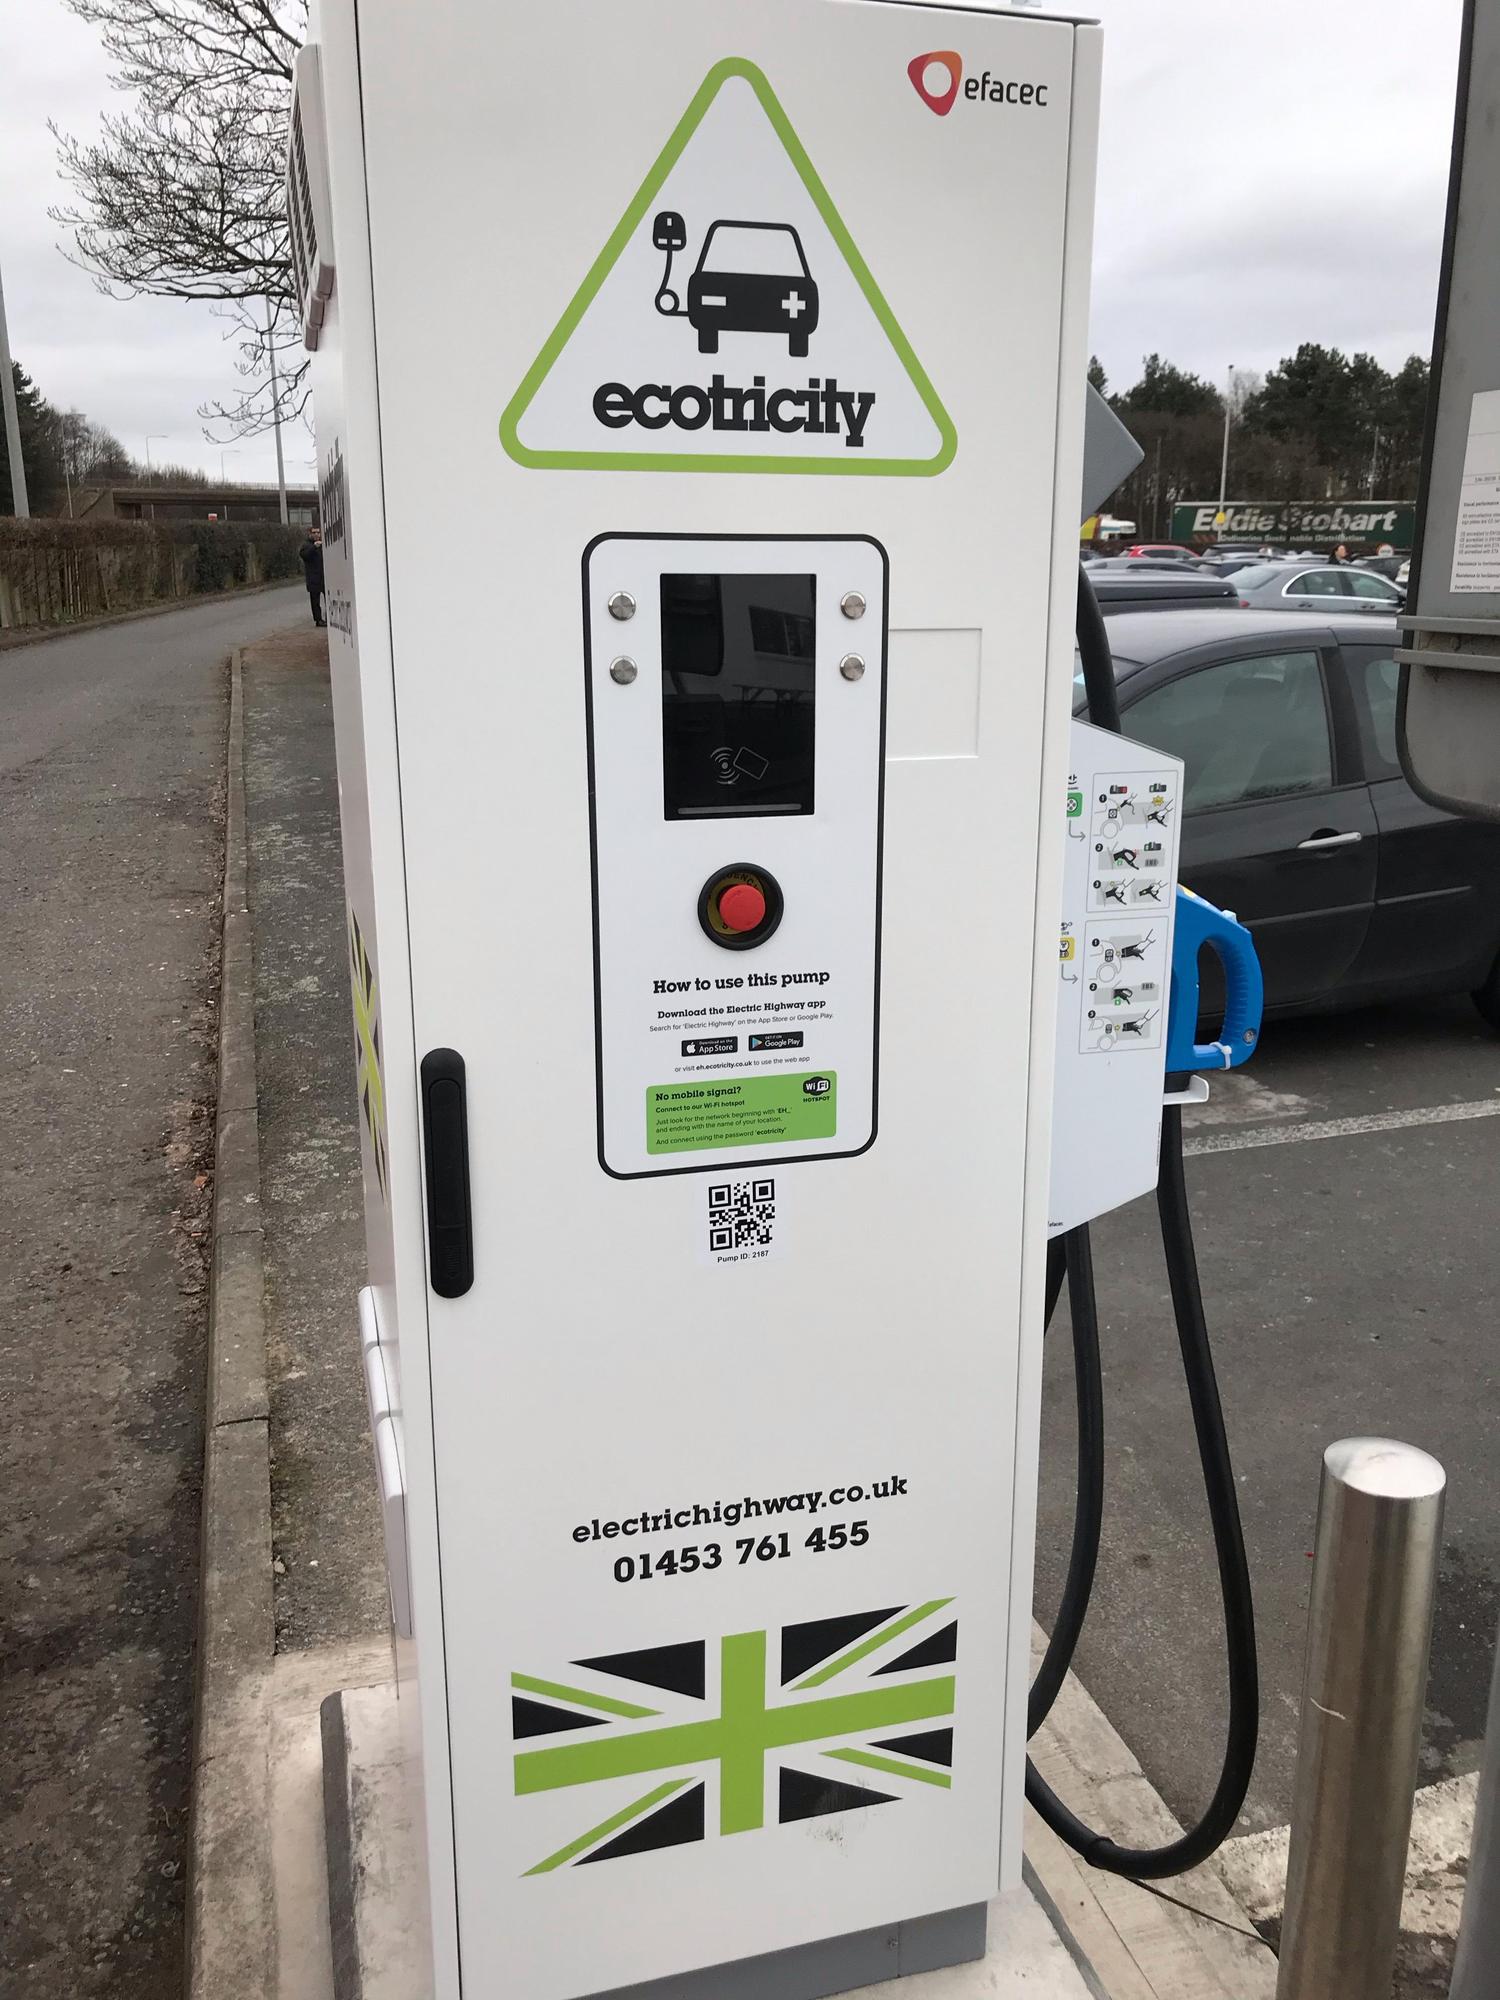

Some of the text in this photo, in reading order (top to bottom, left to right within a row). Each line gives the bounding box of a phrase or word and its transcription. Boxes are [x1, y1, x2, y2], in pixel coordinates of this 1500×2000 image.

[964, 71, 1048, 106] efacec
[592, 374, 876, 447] ecotricity
[1192, 507, 1398, 532] Eddie Stobart
[653, 971, 830, 994] How to use this pump
[657, 1000, 826, 1019] Download the Electric Highway app
[649, 1024, 672, 1032] Search
[673, 1023, 682, 1031] for
[772, 1015, 788, 1023] Store
[797, 1013, 819, 1021] Google
[699, 1044, 734, 1054] App Store
[764, 1038, 801, 1048] Google Play
[695, 1060, 752, 1071] eh.ecotricity.co.uk
[656, 1086, 742, 1101] No mobile signal?
[803, 1095, 830, 1103] HOTSPOT
[656, 1105, 683, 1113] Connect
[721, 1100, 745, 1108] hotspot
[717, 1255, 739, 1263] Pump
[752, 1250, 769, 1258] 2187
[572, 1475, 908, 1543] electrichighway.co.uk
[613, 1520, 870, 1583] 01453 761 455
